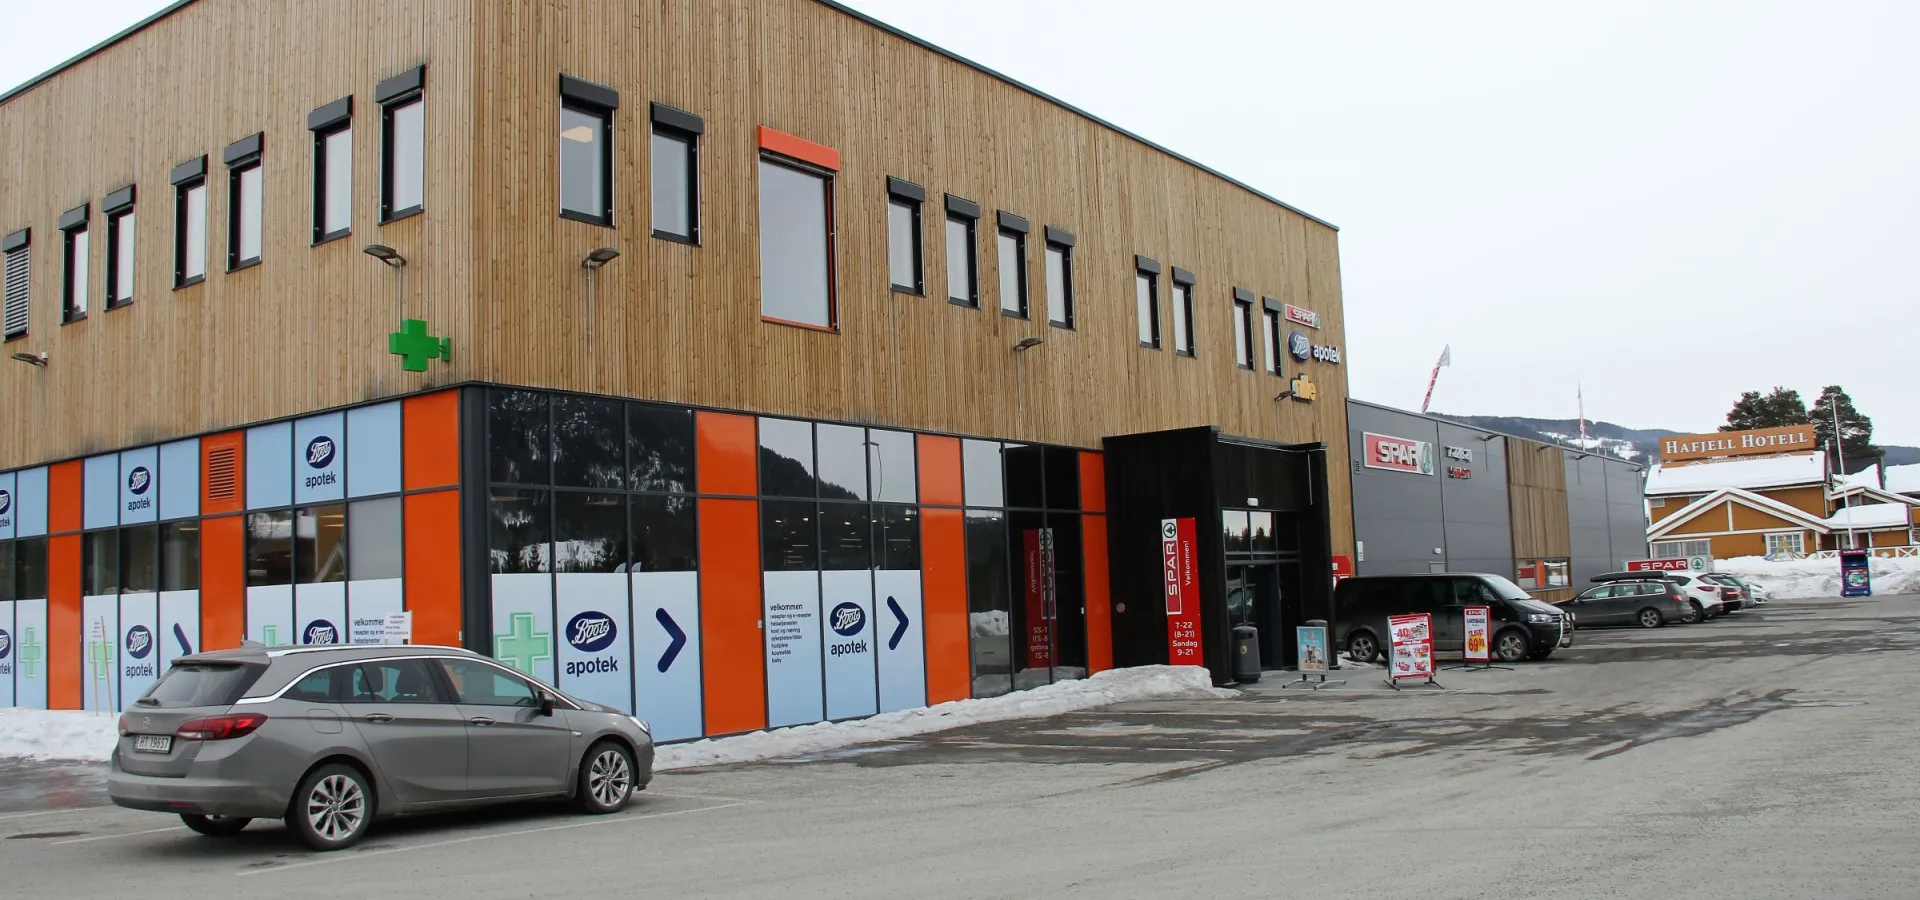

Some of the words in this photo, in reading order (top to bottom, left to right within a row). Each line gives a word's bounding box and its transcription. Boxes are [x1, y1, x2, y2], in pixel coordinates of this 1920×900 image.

[1313, 344, 1341, 364] apotek
[308, 440, 332, 464] Boots
[1665, 439, 1736, 454] HAFJELL
[1741, 432, 1808, 448] HOTELL
[1376, 441, 1418, 467] SPAR
[305, 471, 336, 489] apotek
[127, 497, 151, 512] apotek
[1166, 542, 1178, 596] SPAR
[1183, 540, 1192, 586] Velkommen!
[1640, 560, 1687, 571] SPAR
[770, 603, 803, 611] velkommen
[834, 607, 861, 630] Boots
[1175, 621, 1193, 629] 7-22
[571, 618, 610, 645] Boots
[1174, 629, 1195, 638] (8-21)
[830, 639, 868, 658] apotek
[1172, 639, 1198, 649] Søndag
[1177, 648, 1194, 656] 9-21
[126, 663, 153, 679] apotek
[566, 655, 618, 678] apotek
